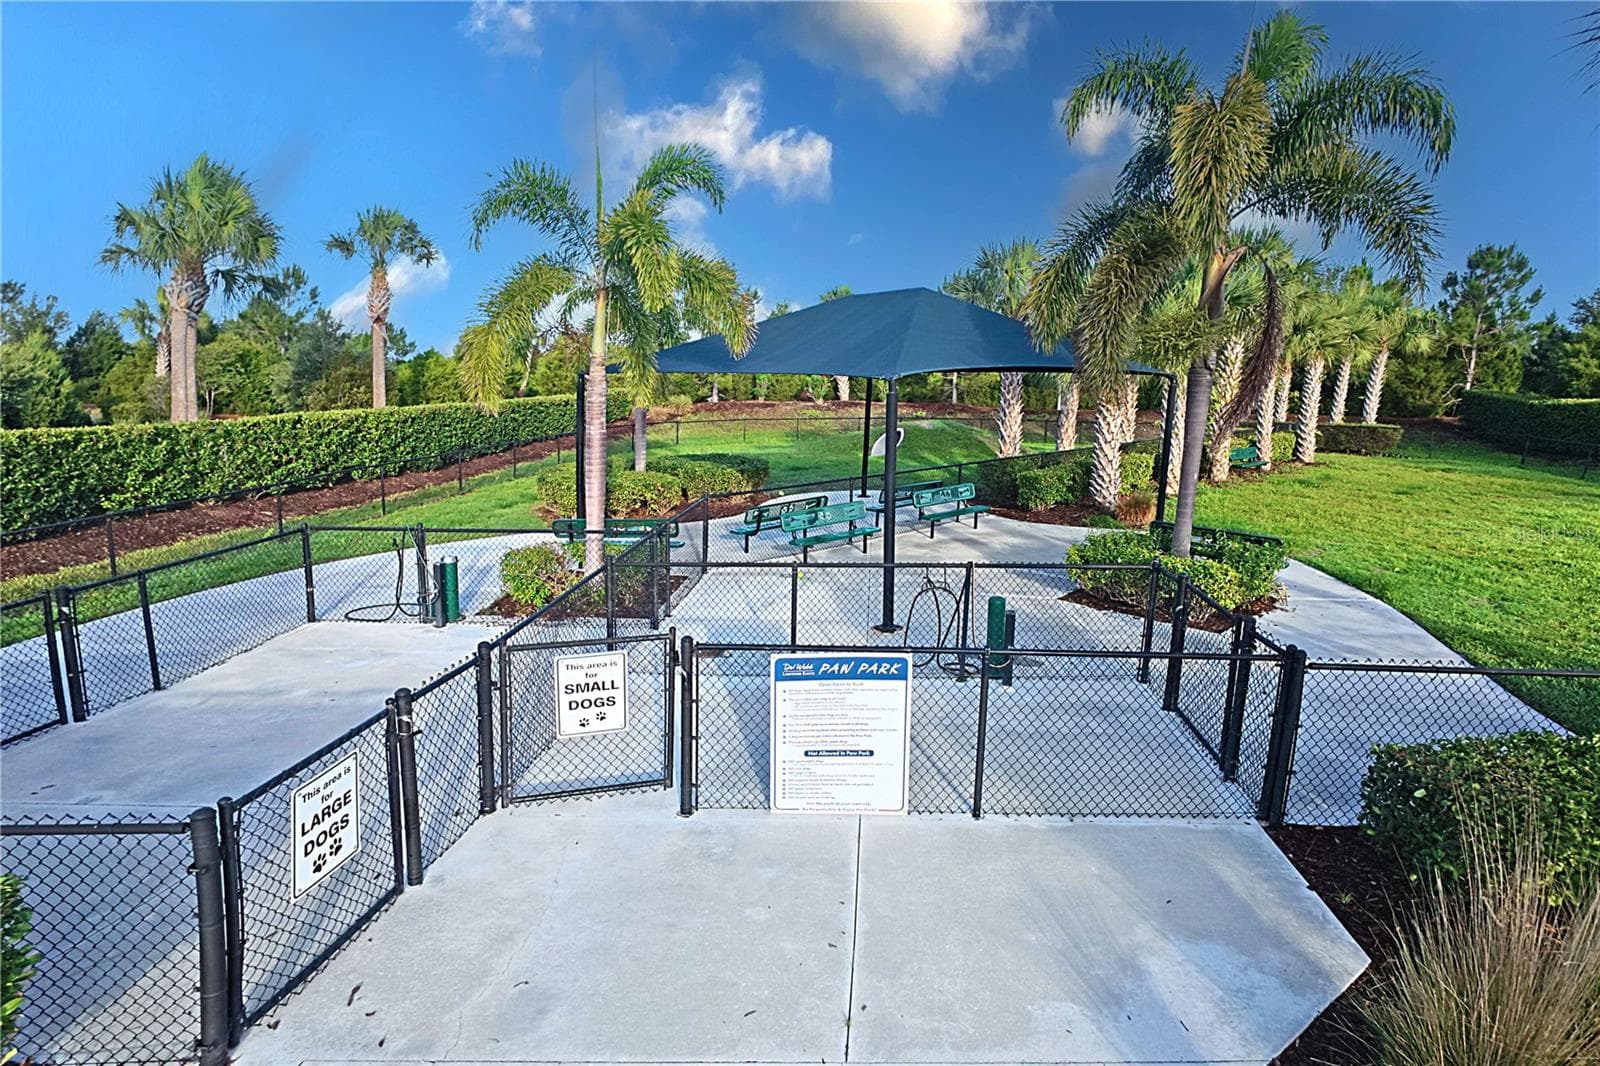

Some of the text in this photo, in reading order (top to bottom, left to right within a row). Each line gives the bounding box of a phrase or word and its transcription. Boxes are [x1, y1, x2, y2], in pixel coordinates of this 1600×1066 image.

[565, 662, 584, 671] This
[609, 659, 618, 667] is
[818, 661, 902, 675] PAW PARK
[564, 680, 619, 695] SMALL
[568, 696, 616, 711] DOGS
[301, 766, 352, 804] This area is
[321, 790, 334, 804] for
[301, 788, 352, 837] LARGE
[304, 813, 350, 858] DOGS
